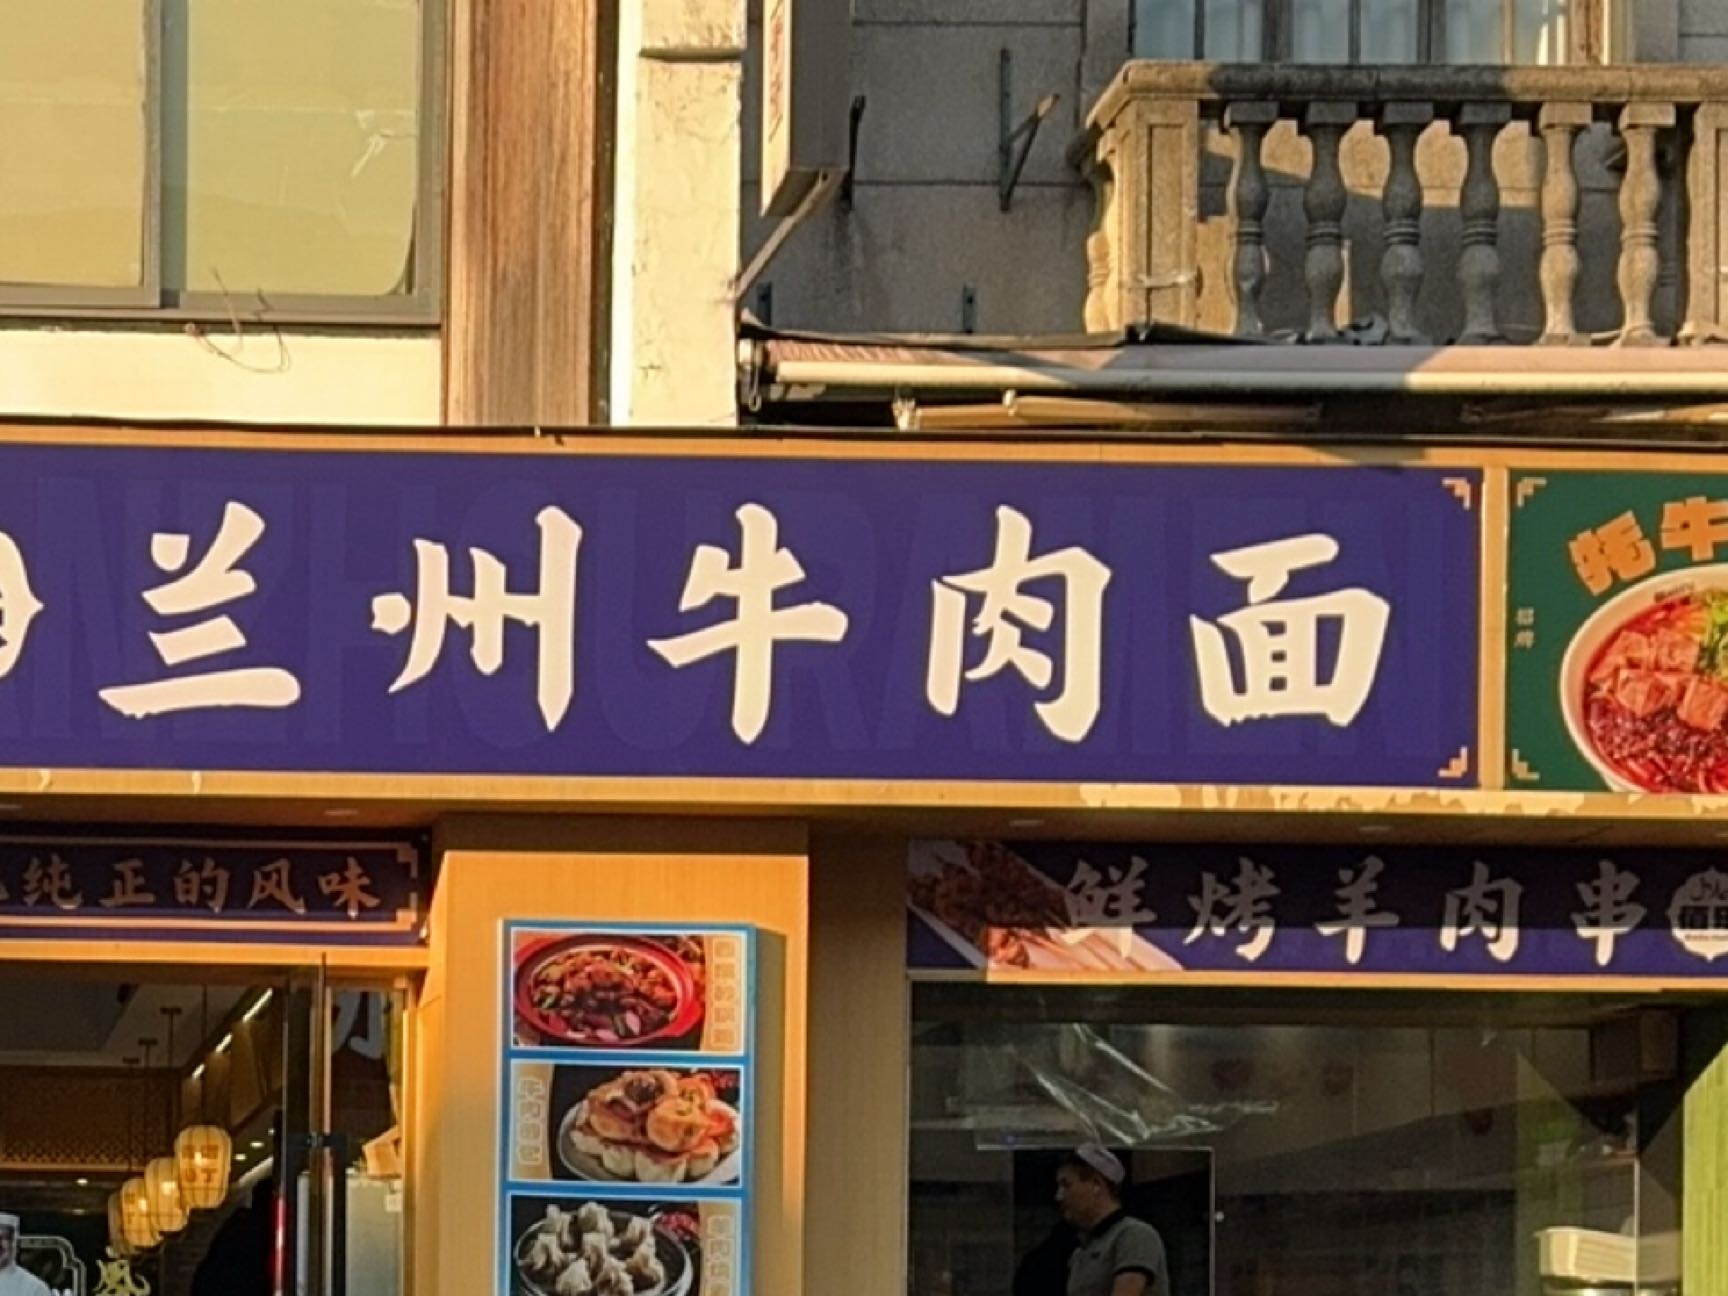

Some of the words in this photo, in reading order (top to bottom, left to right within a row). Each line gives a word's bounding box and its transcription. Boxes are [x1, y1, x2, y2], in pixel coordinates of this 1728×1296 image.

[98, 500, 1392, 745] 兰州牛肉面
[1064, 854, 1650, 966] 鲜烤羊肉串
